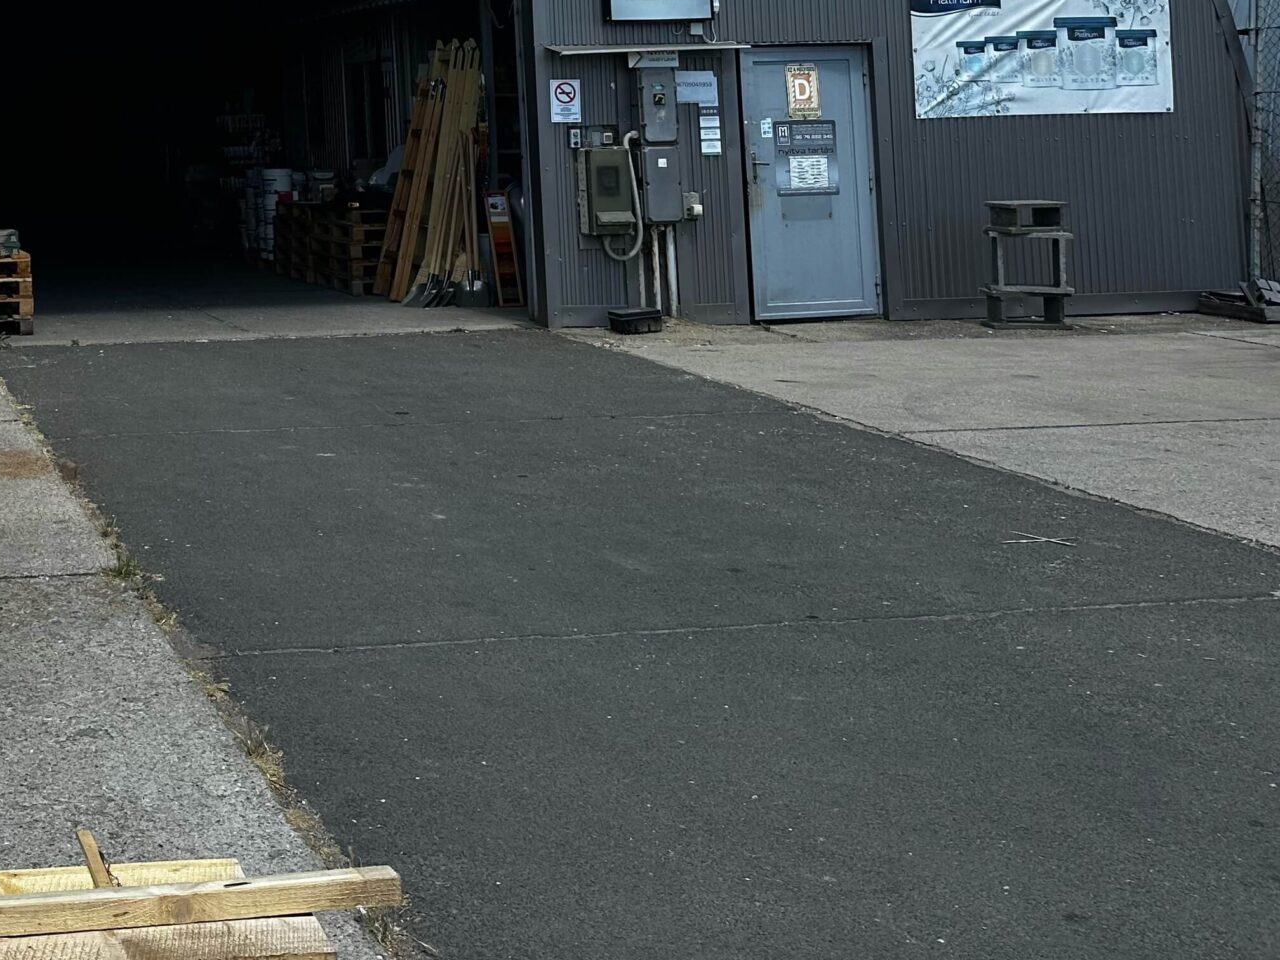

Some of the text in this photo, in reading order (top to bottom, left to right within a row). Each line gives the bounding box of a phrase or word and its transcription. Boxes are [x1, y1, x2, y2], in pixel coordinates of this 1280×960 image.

[794, 78, 810, 100] D
[778, 145, 834, 156] nyitva tartás
